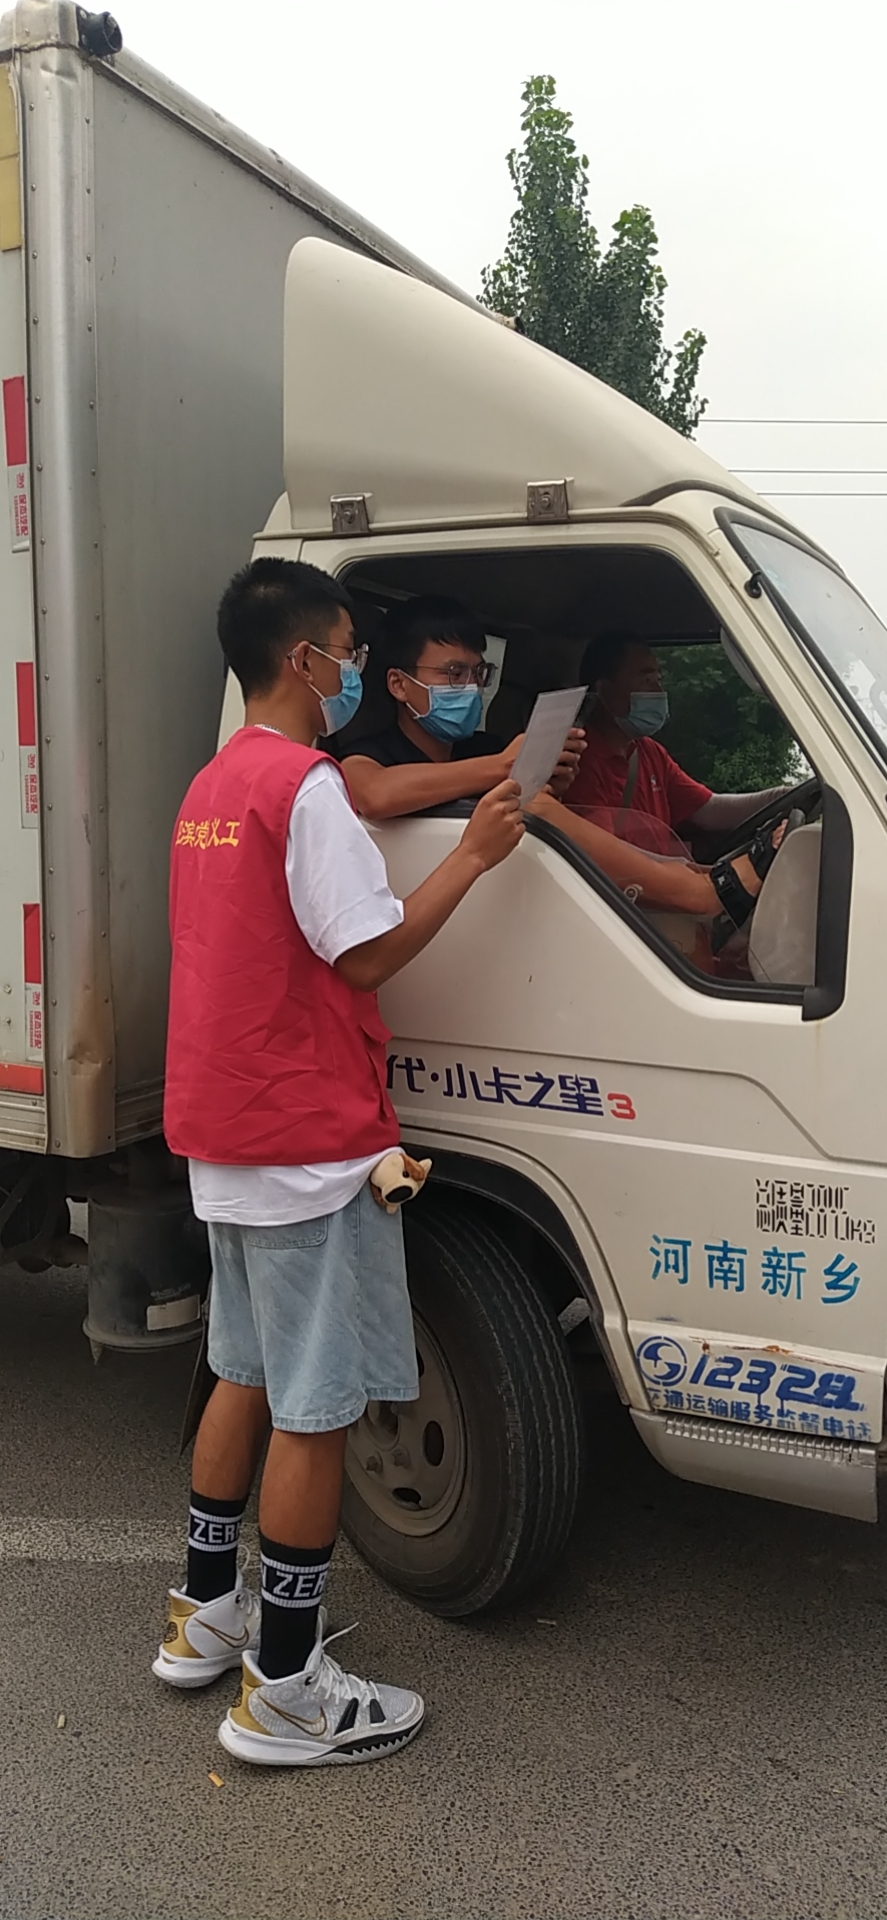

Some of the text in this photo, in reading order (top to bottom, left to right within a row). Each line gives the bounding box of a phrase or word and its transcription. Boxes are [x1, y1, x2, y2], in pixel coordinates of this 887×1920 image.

[649, 1234, 861, 1304] 河南新乡
[689, 1353, 865, 1412] 12328
